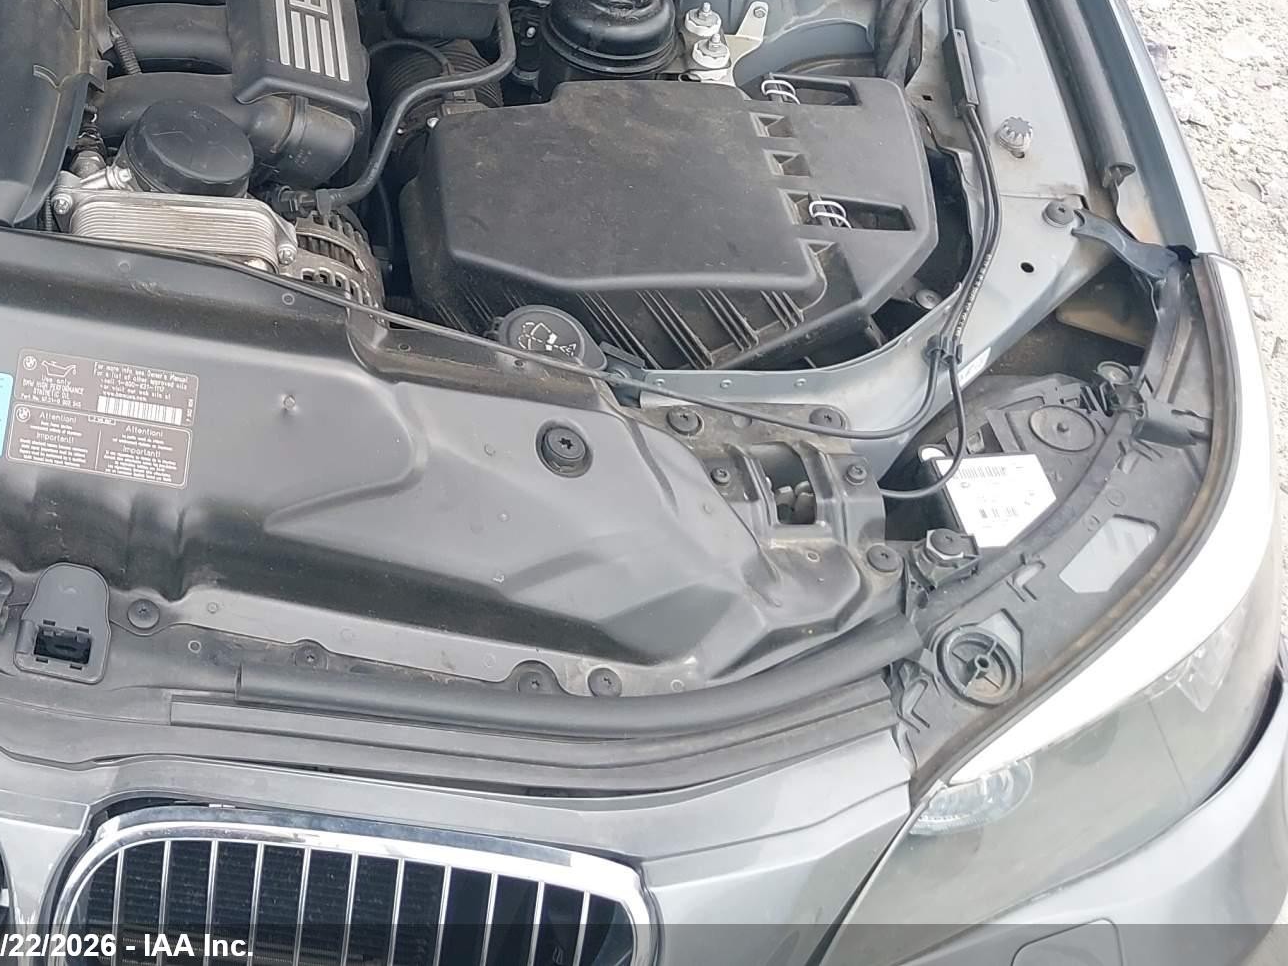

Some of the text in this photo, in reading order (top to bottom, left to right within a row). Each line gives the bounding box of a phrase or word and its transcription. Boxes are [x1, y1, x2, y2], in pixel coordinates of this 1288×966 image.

[22, 378, 34, 387] BMW
[42, 374, 71, 387] Use only
[40, 411, 77, 423] Attention!
[125, 425, 163, 438] Attention!
[36, 432, 74, 443] Important!
[122, 446, 161, 457] Important!
